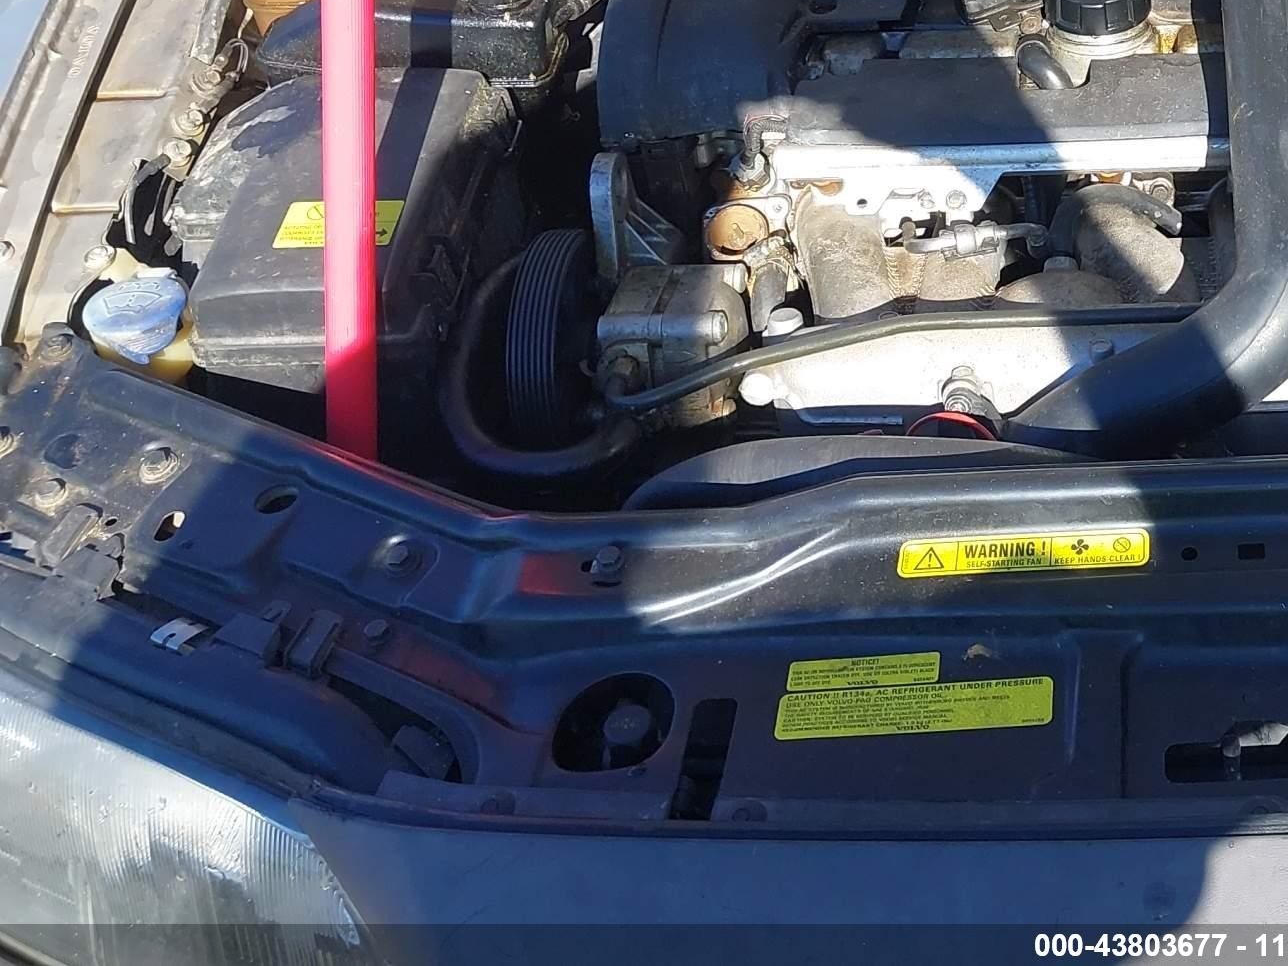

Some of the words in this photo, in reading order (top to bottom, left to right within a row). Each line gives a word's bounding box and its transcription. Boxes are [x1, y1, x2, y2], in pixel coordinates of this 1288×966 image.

[964, 542, 1035, 558] WARNING
[966, 558, 1024, 568] SELF-STARTING
[1026, 557, 1042, 566] FAN
[787, 692, 829, 701] CAUTION
[892, 684, 955, 694] REFRIGERANT
[960, 681, 992, 690] UNDER
[994, 678, 1044, 688] PRESSURE
[874, 693, 928, 702] COMPRESSOR
